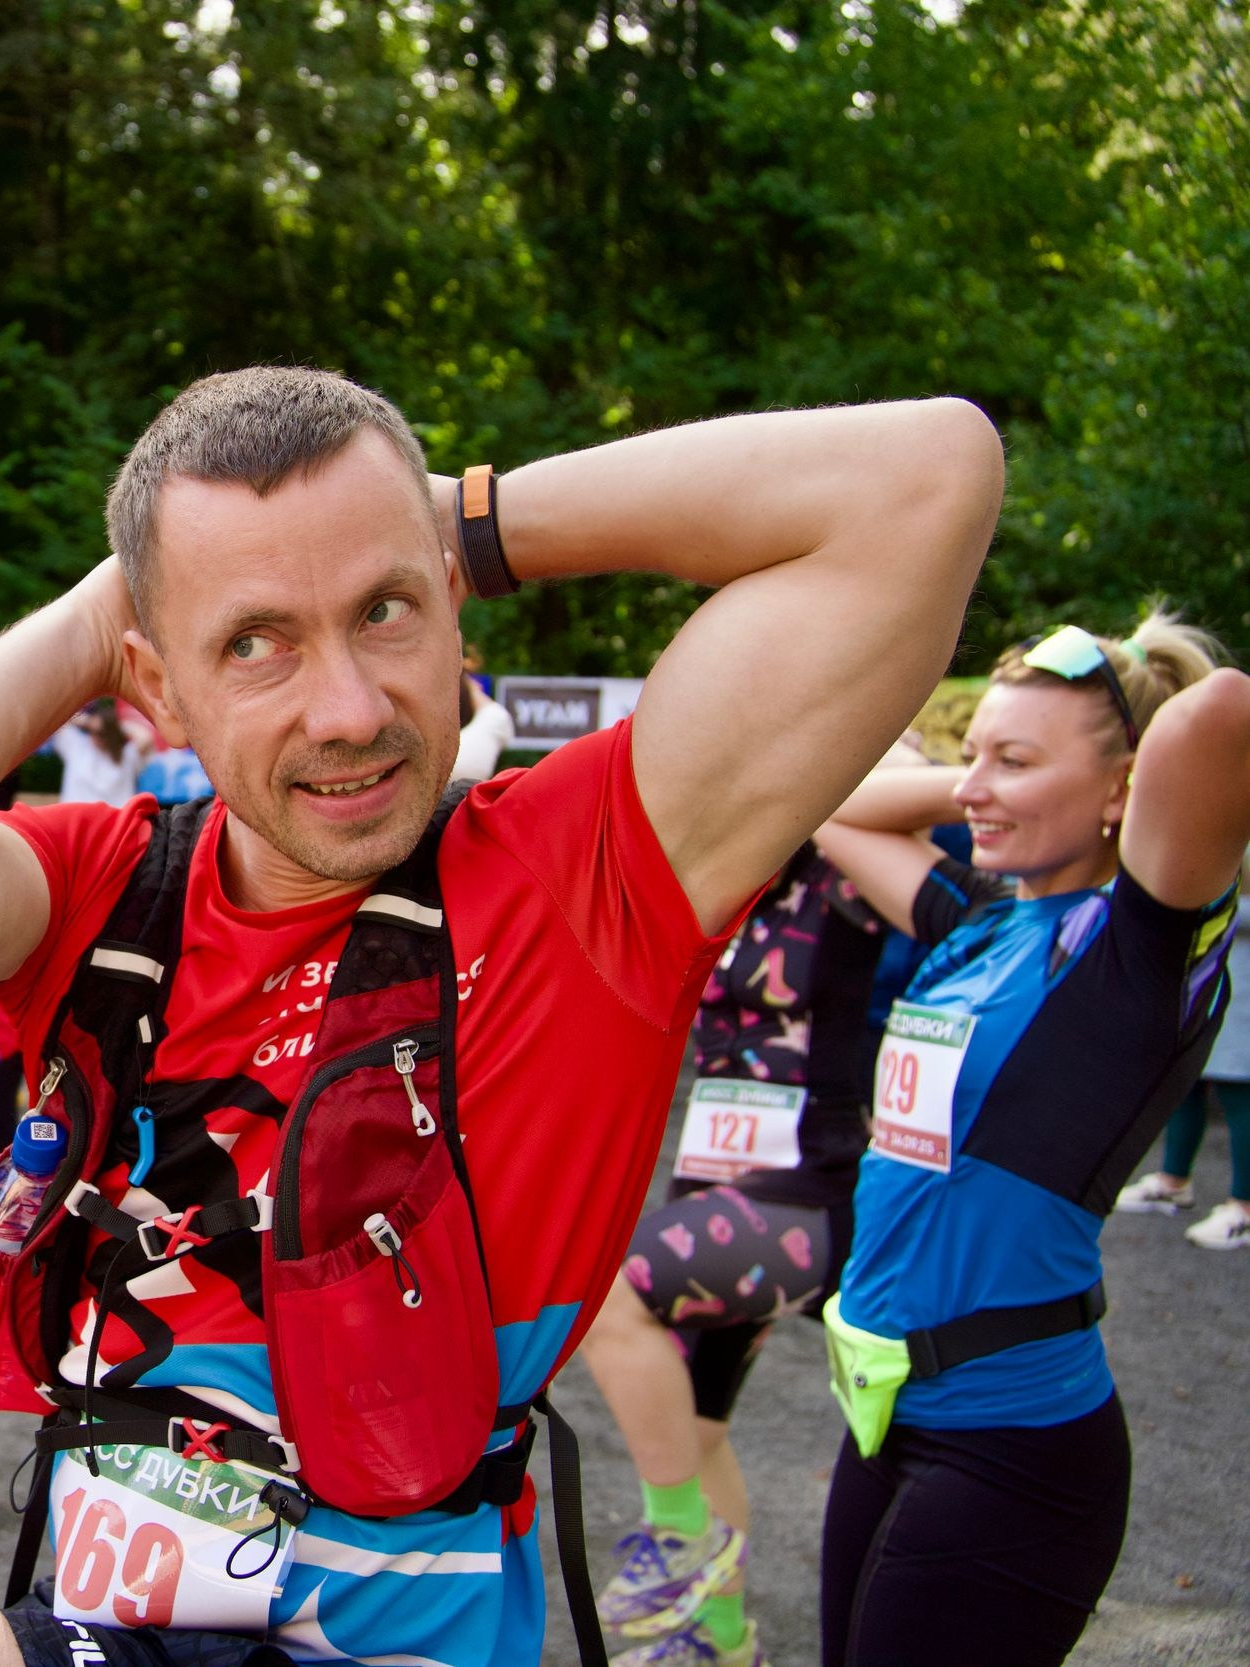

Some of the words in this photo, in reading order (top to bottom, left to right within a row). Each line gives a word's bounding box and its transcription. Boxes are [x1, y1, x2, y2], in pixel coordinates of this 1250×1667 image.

[709, 1111, 760, 1153] 127
[135, 1451, 261, 1522] ДУБКИ
[55, 1487, 184, 1629] 169
